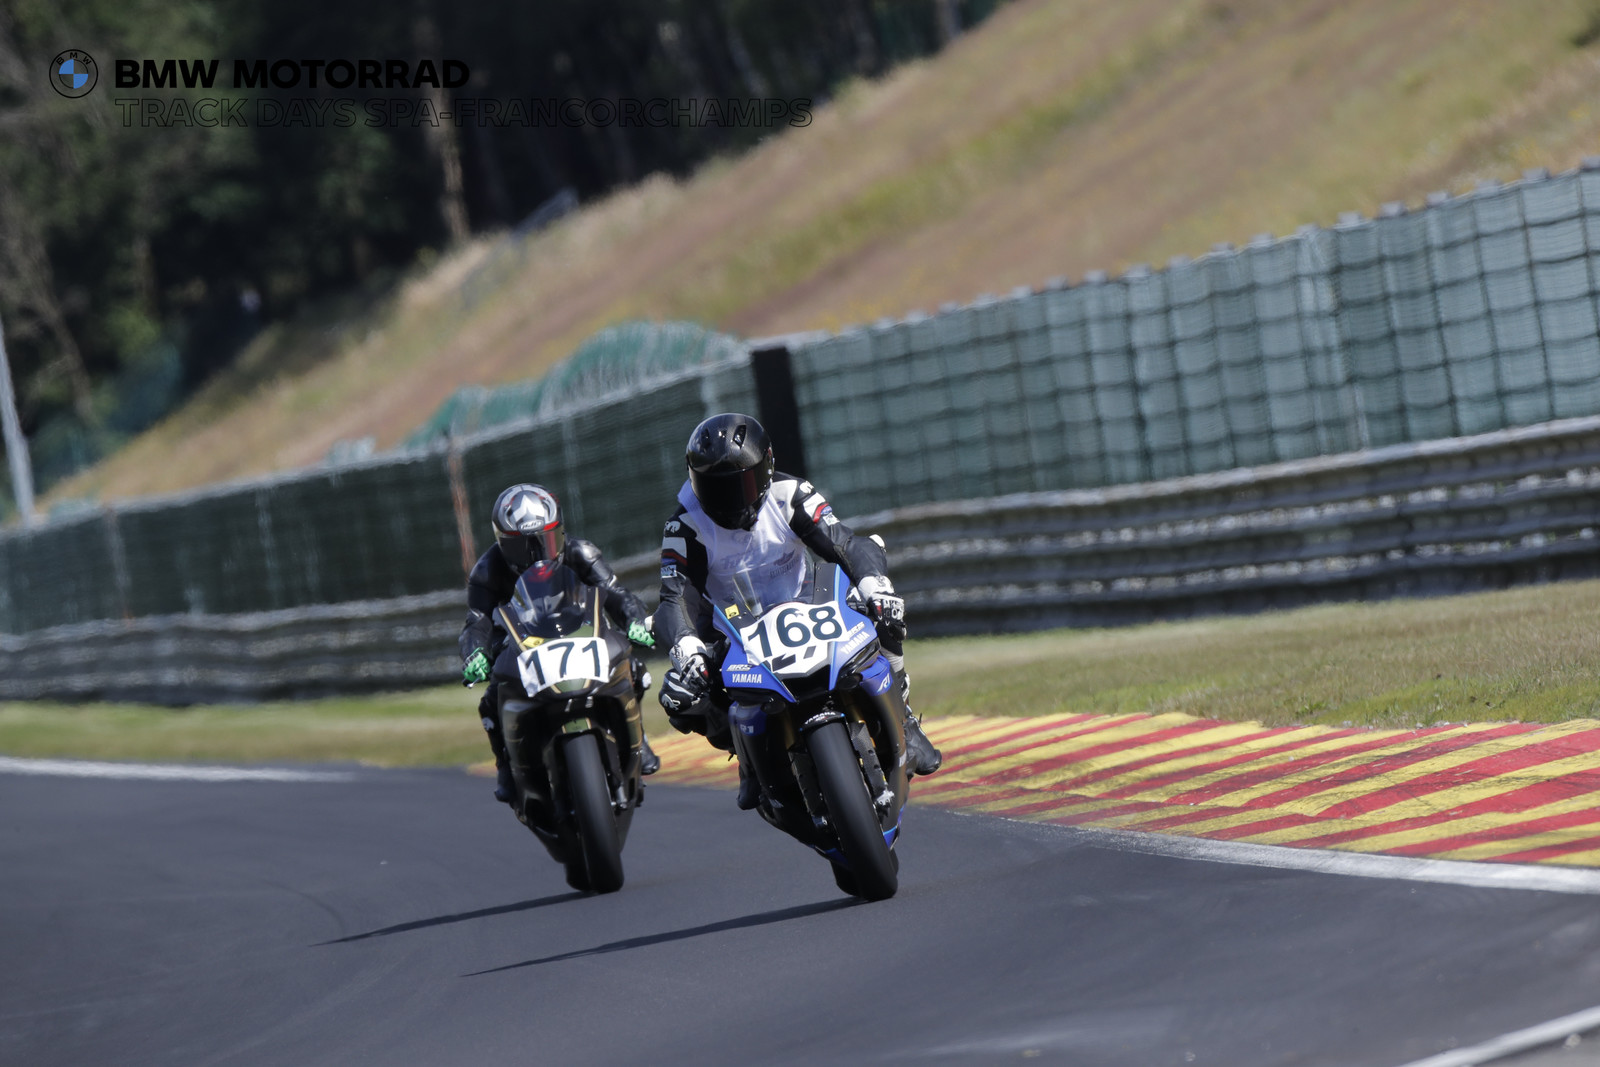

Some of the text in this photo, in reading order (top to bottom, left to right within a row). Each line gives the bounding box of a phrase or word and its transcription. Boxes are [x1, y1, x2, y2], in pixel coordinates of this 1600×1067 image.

[747, 605, 843, 658] 168
[840, 630, 871, 655] YAMAHA
[524, 639, 601, 687] 171
[732, 673, 762, 684] YAMAHA
